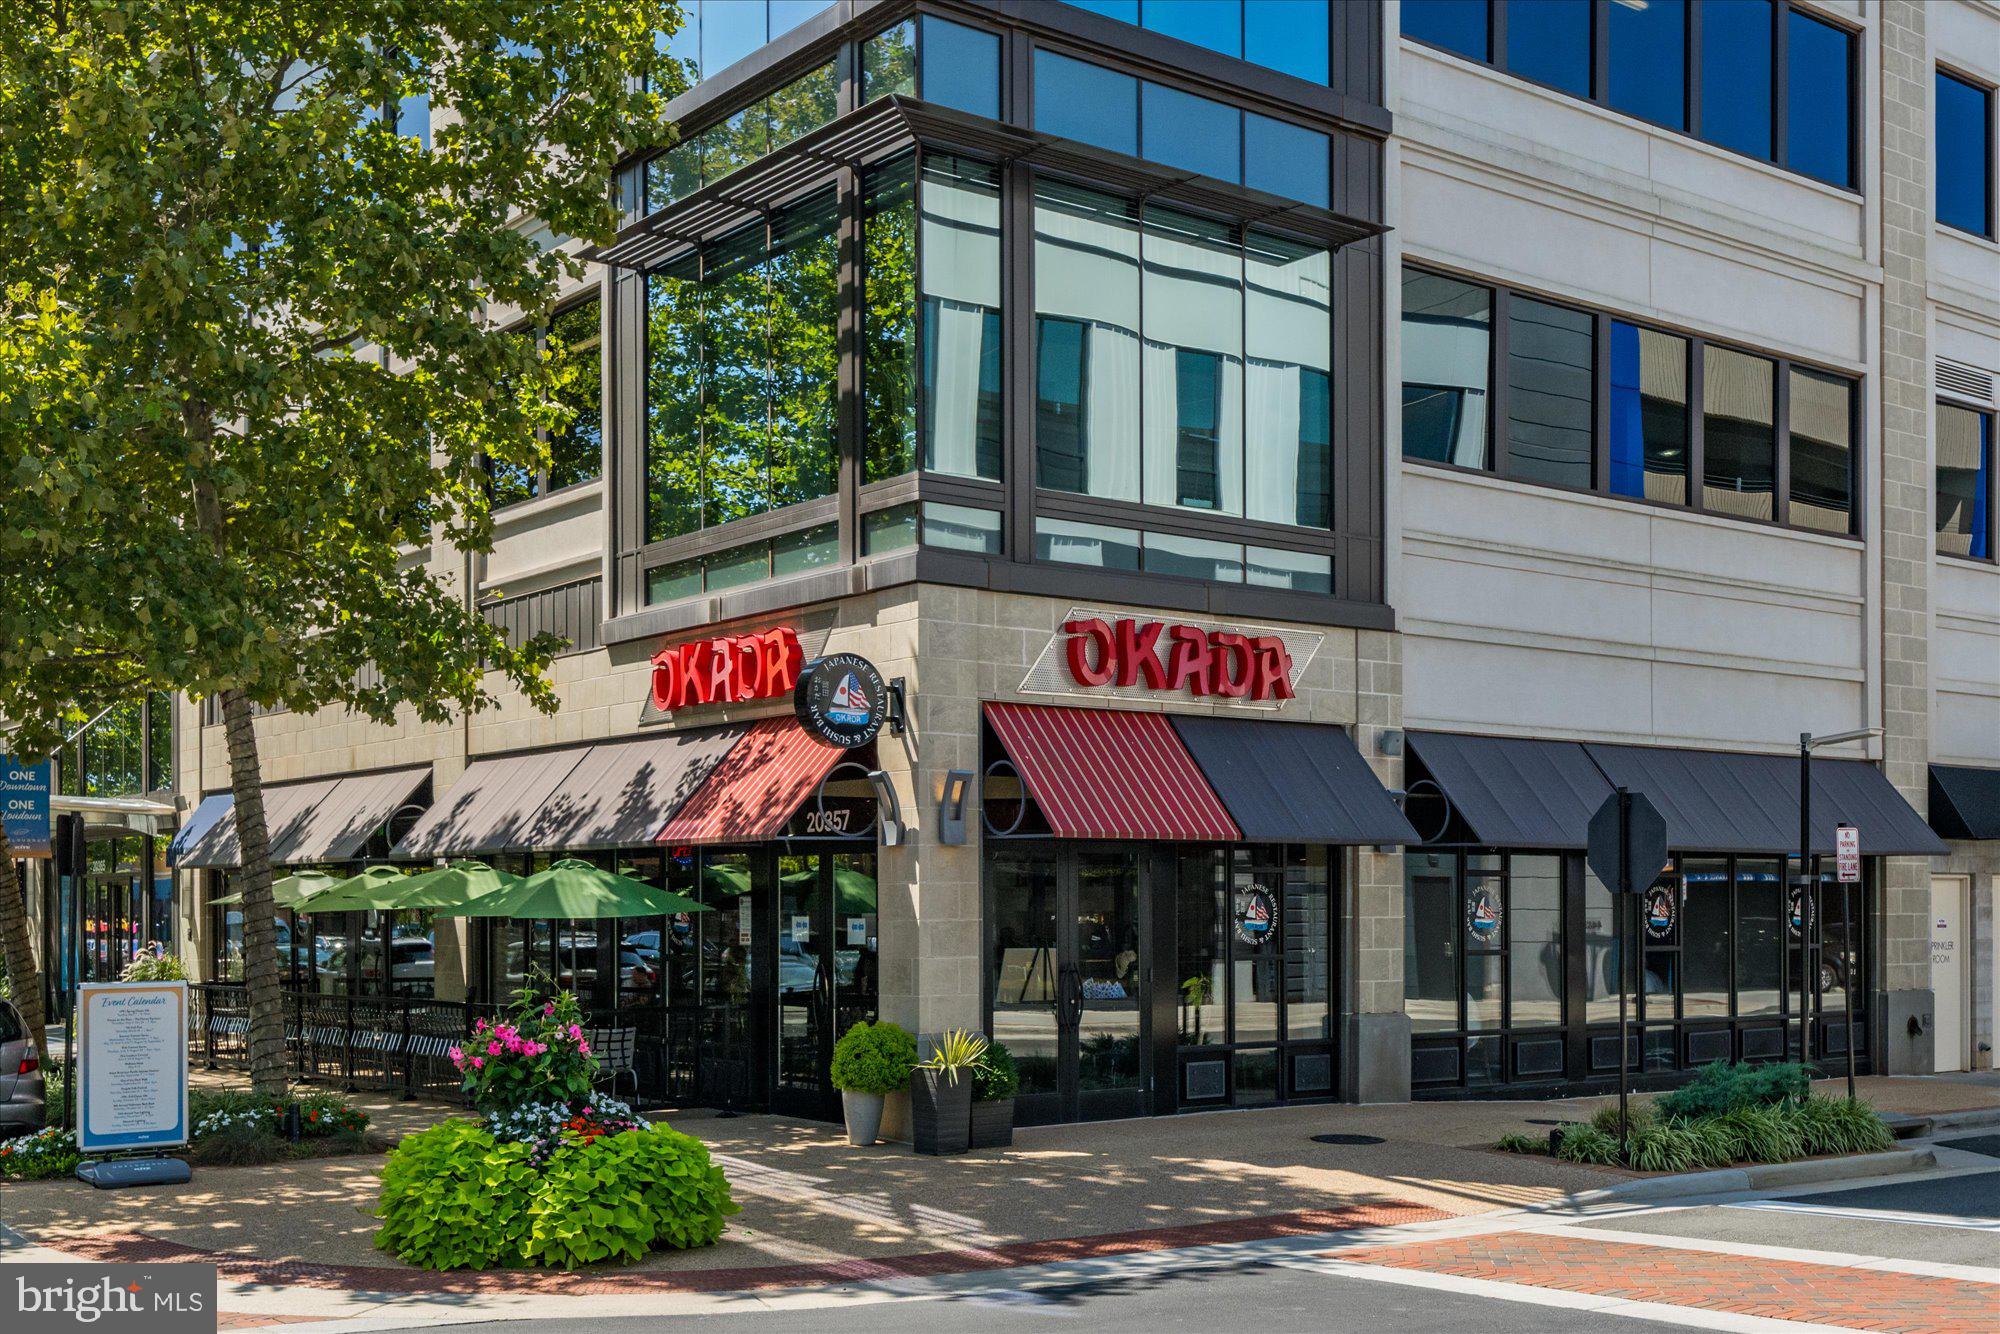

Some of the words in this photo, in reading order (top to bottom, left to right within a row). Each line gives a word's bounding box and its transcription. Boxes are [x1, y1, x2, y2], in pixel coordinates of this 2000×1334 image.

[823, 655, 869, 672] JAPANESE
[1065, 618, 1296, 700] OKADA
[651, 627, 804, 711] OKADA
[863, 672, 885, 740] RESTAURANT
[810, 704, 824, 725] BAR
[835, 713, 861, 723] OKADA
[822, 726, 851, 745] SUSHI
[853, 734, 861, 743] &
[9, 770, 36, 781] ONE
[0, 780, 47, 792] Downtown
[8, 799, 35, 810] ONE
[1, 809, 42, 821] Loudoun
[806, 809, 850, 833] 20357
[101, 997, 126, 1007] Event
[128, 996, 166, 1007] Calendar
